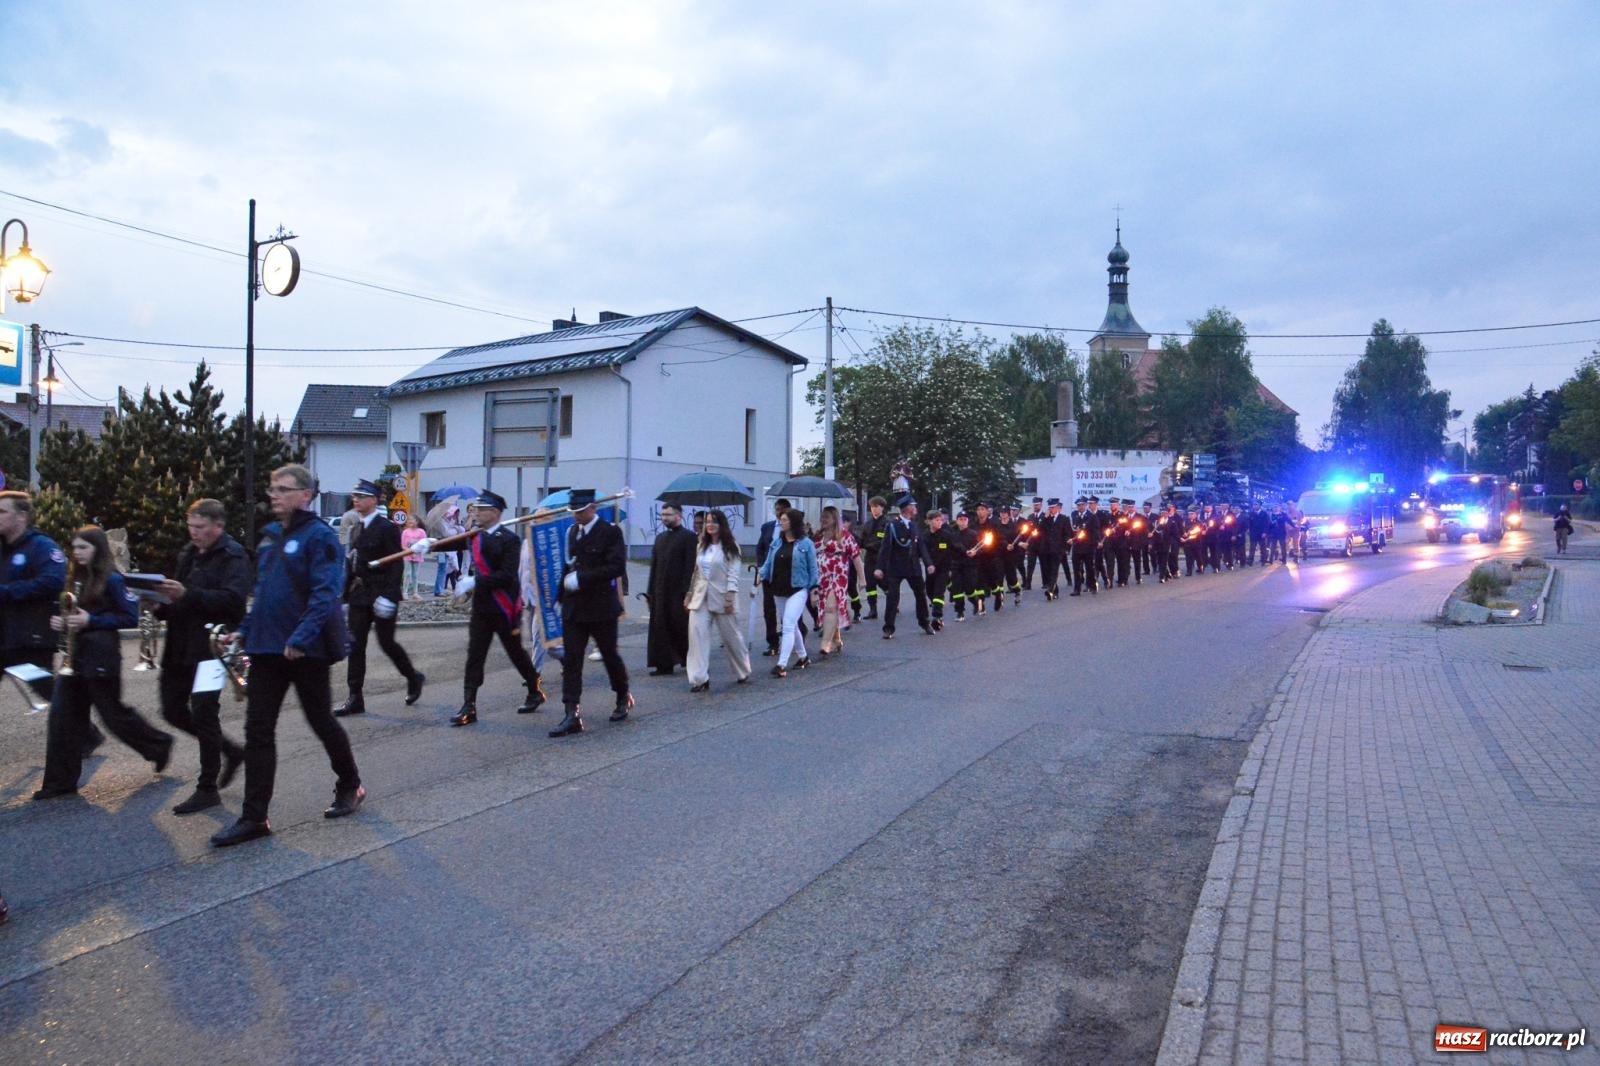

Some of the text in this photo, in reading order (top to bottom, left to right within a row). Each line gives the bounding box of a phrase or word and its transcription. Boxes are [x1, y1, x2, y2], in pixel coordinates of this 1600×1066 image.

[1076, 471, 1118, 479] 570 333 007
